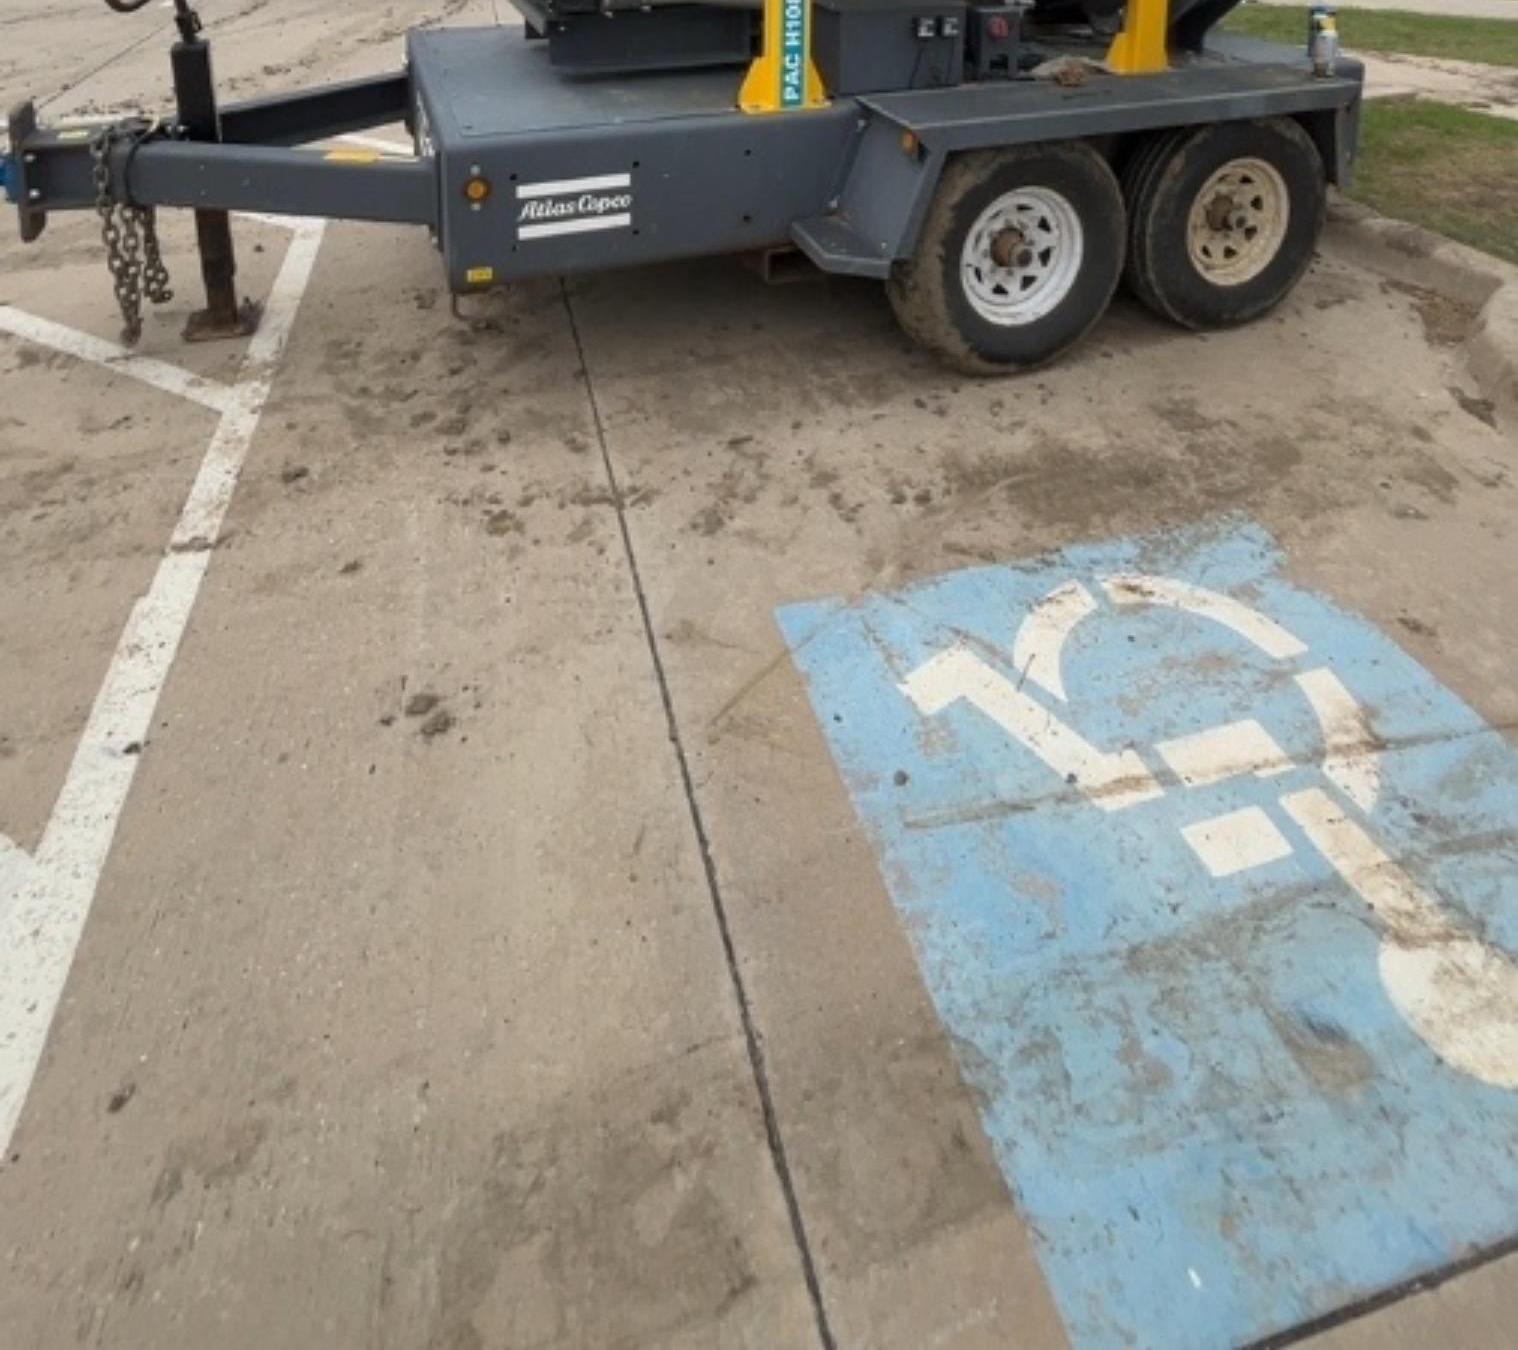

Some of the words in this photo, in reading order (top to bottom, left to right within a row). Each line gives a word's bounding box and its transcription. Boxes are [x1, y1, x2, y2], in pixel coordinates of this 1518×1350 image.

[784, 52, 800, 100] PAC
[517, 199, 577, 221] Atlas
[578, 193, 633, 214] Copco
